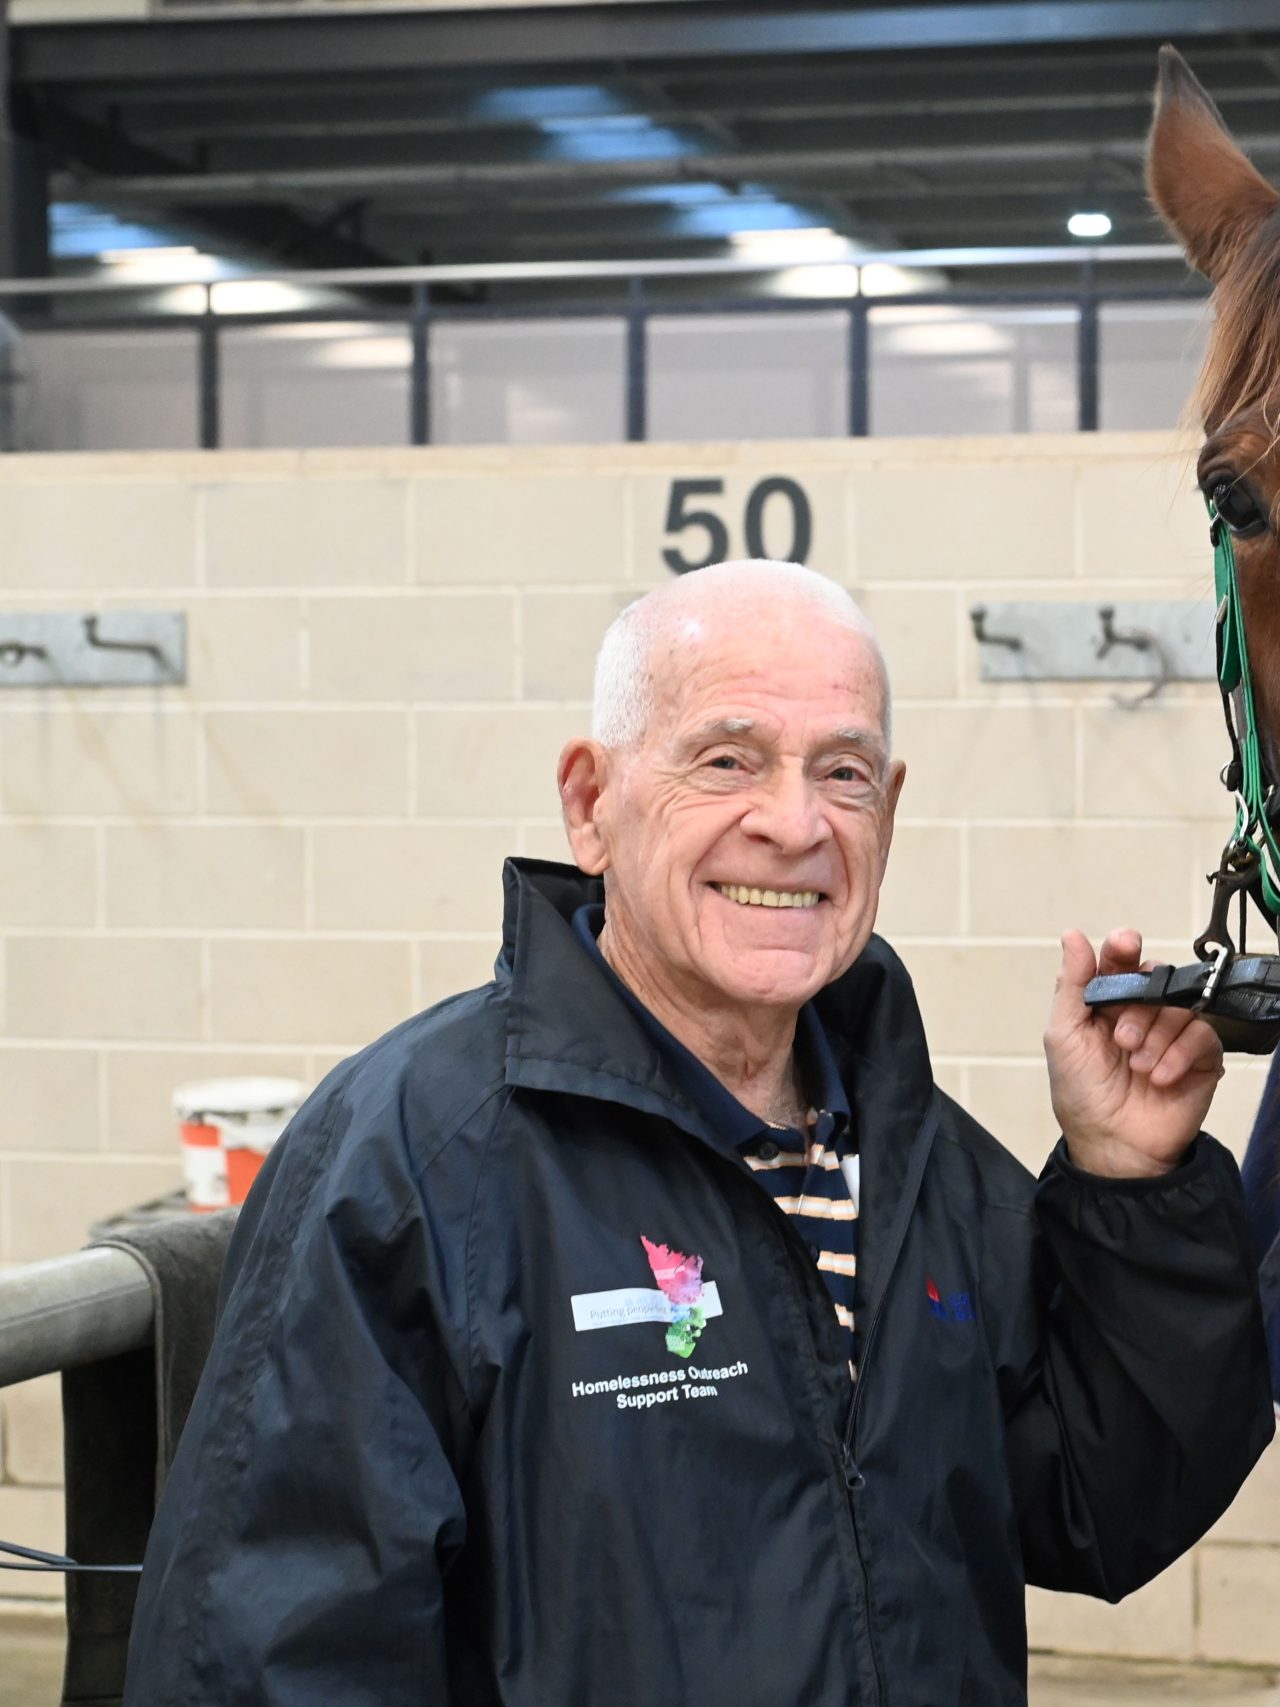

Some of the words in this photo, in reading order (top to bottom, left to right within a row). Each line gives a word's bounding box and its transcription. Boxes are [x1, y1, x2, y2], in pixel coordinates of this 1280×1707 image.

[661, 475, 813, 576] 50
[589, 1307, 626, 1320] Putting
[571, 1367, 686, 1398] Homelessness
[687, 1360, 749, 1380] Outreach
[616, 1386, 680, 1410] Support
[681, 1383, 718, 1400] Team
